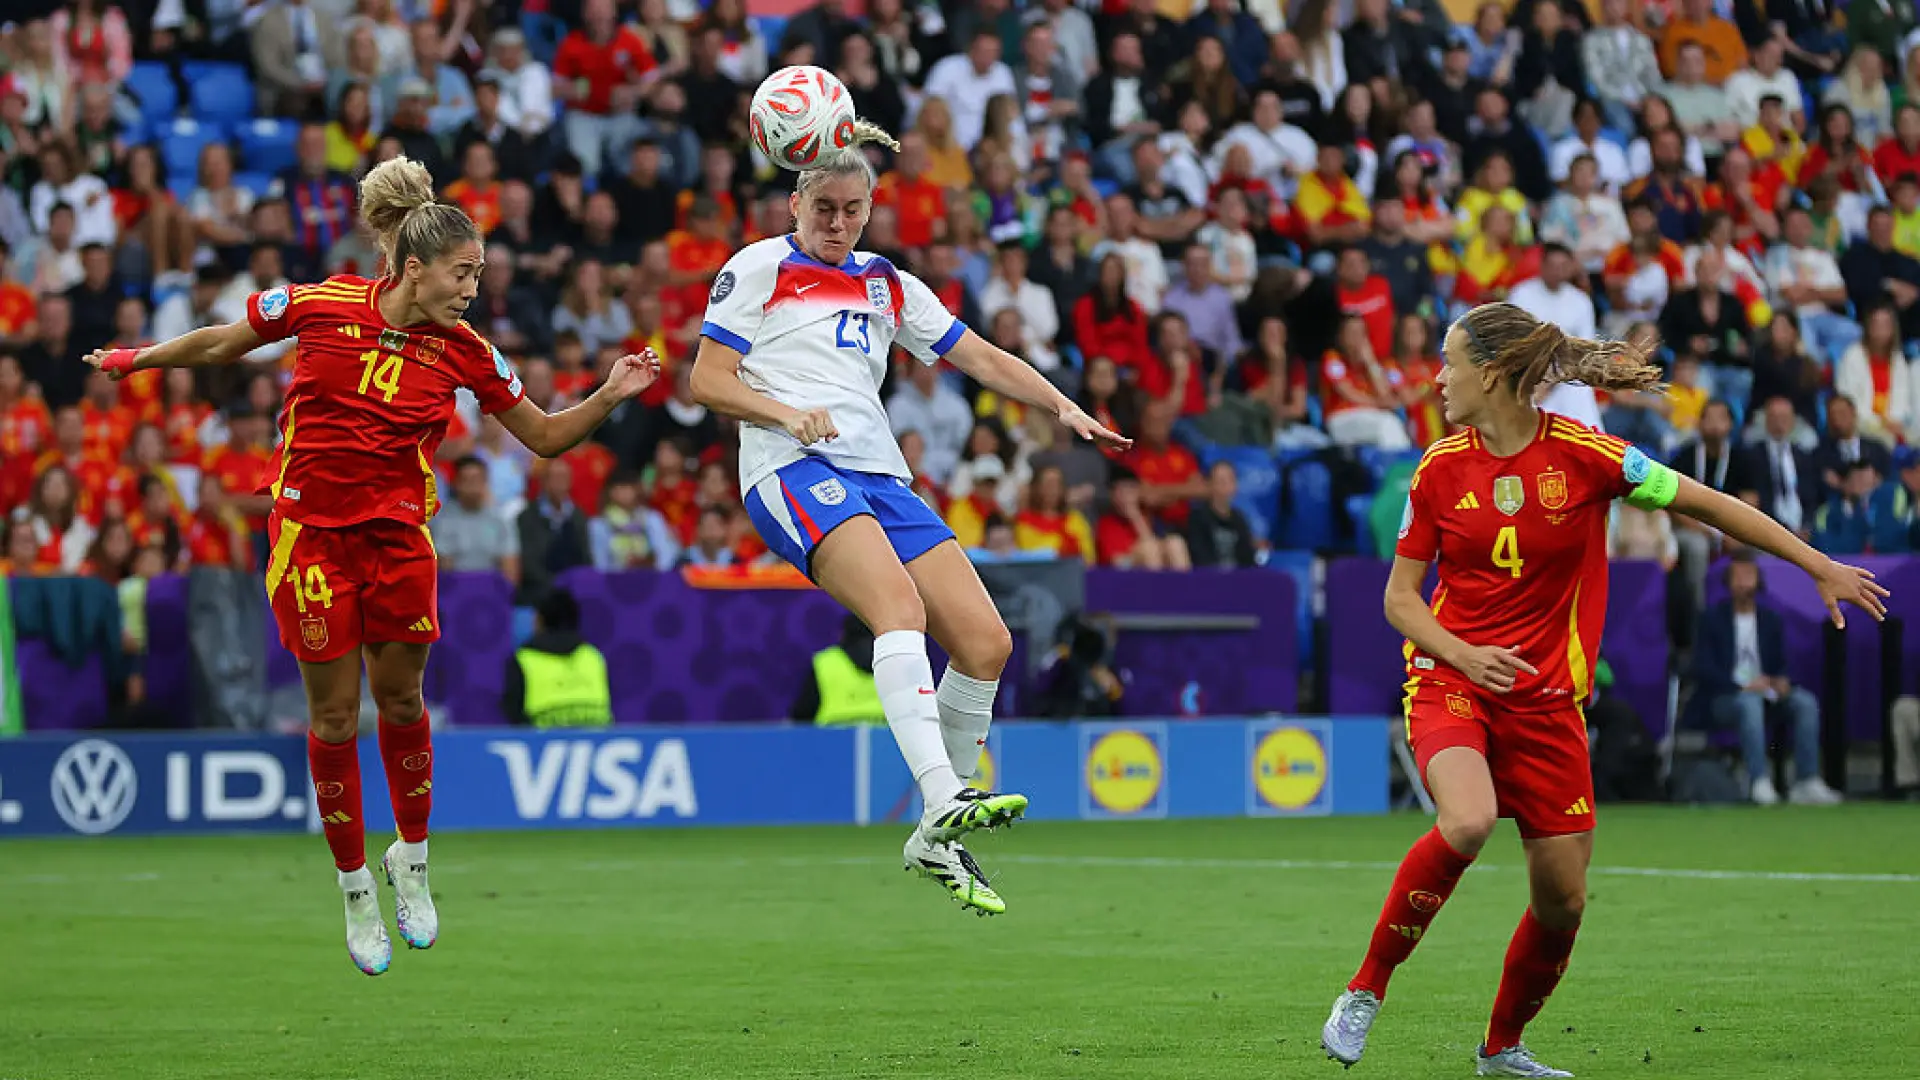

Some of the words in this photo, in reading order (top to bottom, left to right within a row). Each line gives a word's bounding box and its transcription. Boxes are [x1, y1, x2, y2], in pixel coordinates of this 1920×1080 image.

[835, 309, 871, 354] 23
[357, 348, 404, 403] 14
[1491, 525, 1525, 579] 4
[286, 565, 333, 613] 14
[166, 751, 306, 821] ID.
[487, 737, 698, 820] VISA
